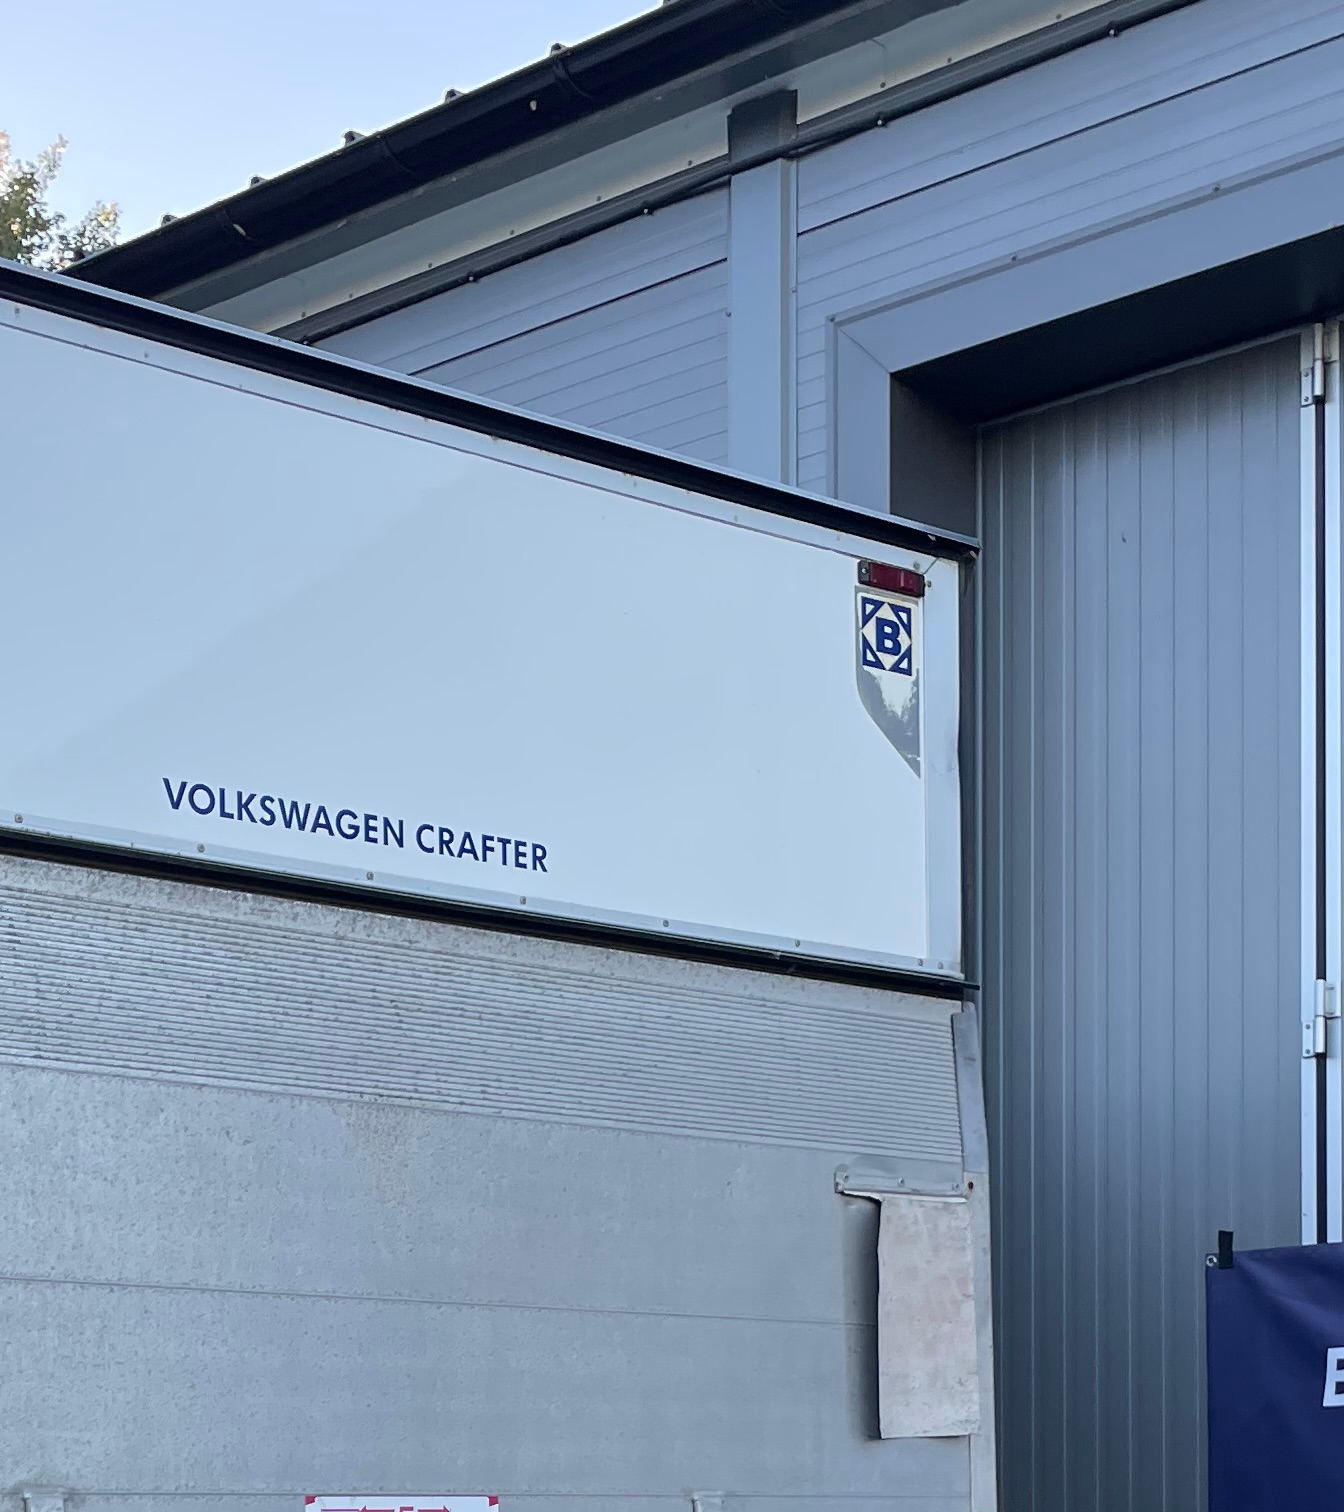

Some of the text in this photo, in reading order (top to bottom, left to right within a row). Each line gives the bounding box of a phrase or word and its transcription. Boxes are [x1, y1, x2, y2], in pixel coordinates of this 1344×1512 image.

[875, 616, 902, 656] B
[162, 777, 549, 873] VOLKSWAGEN CRAFTER
